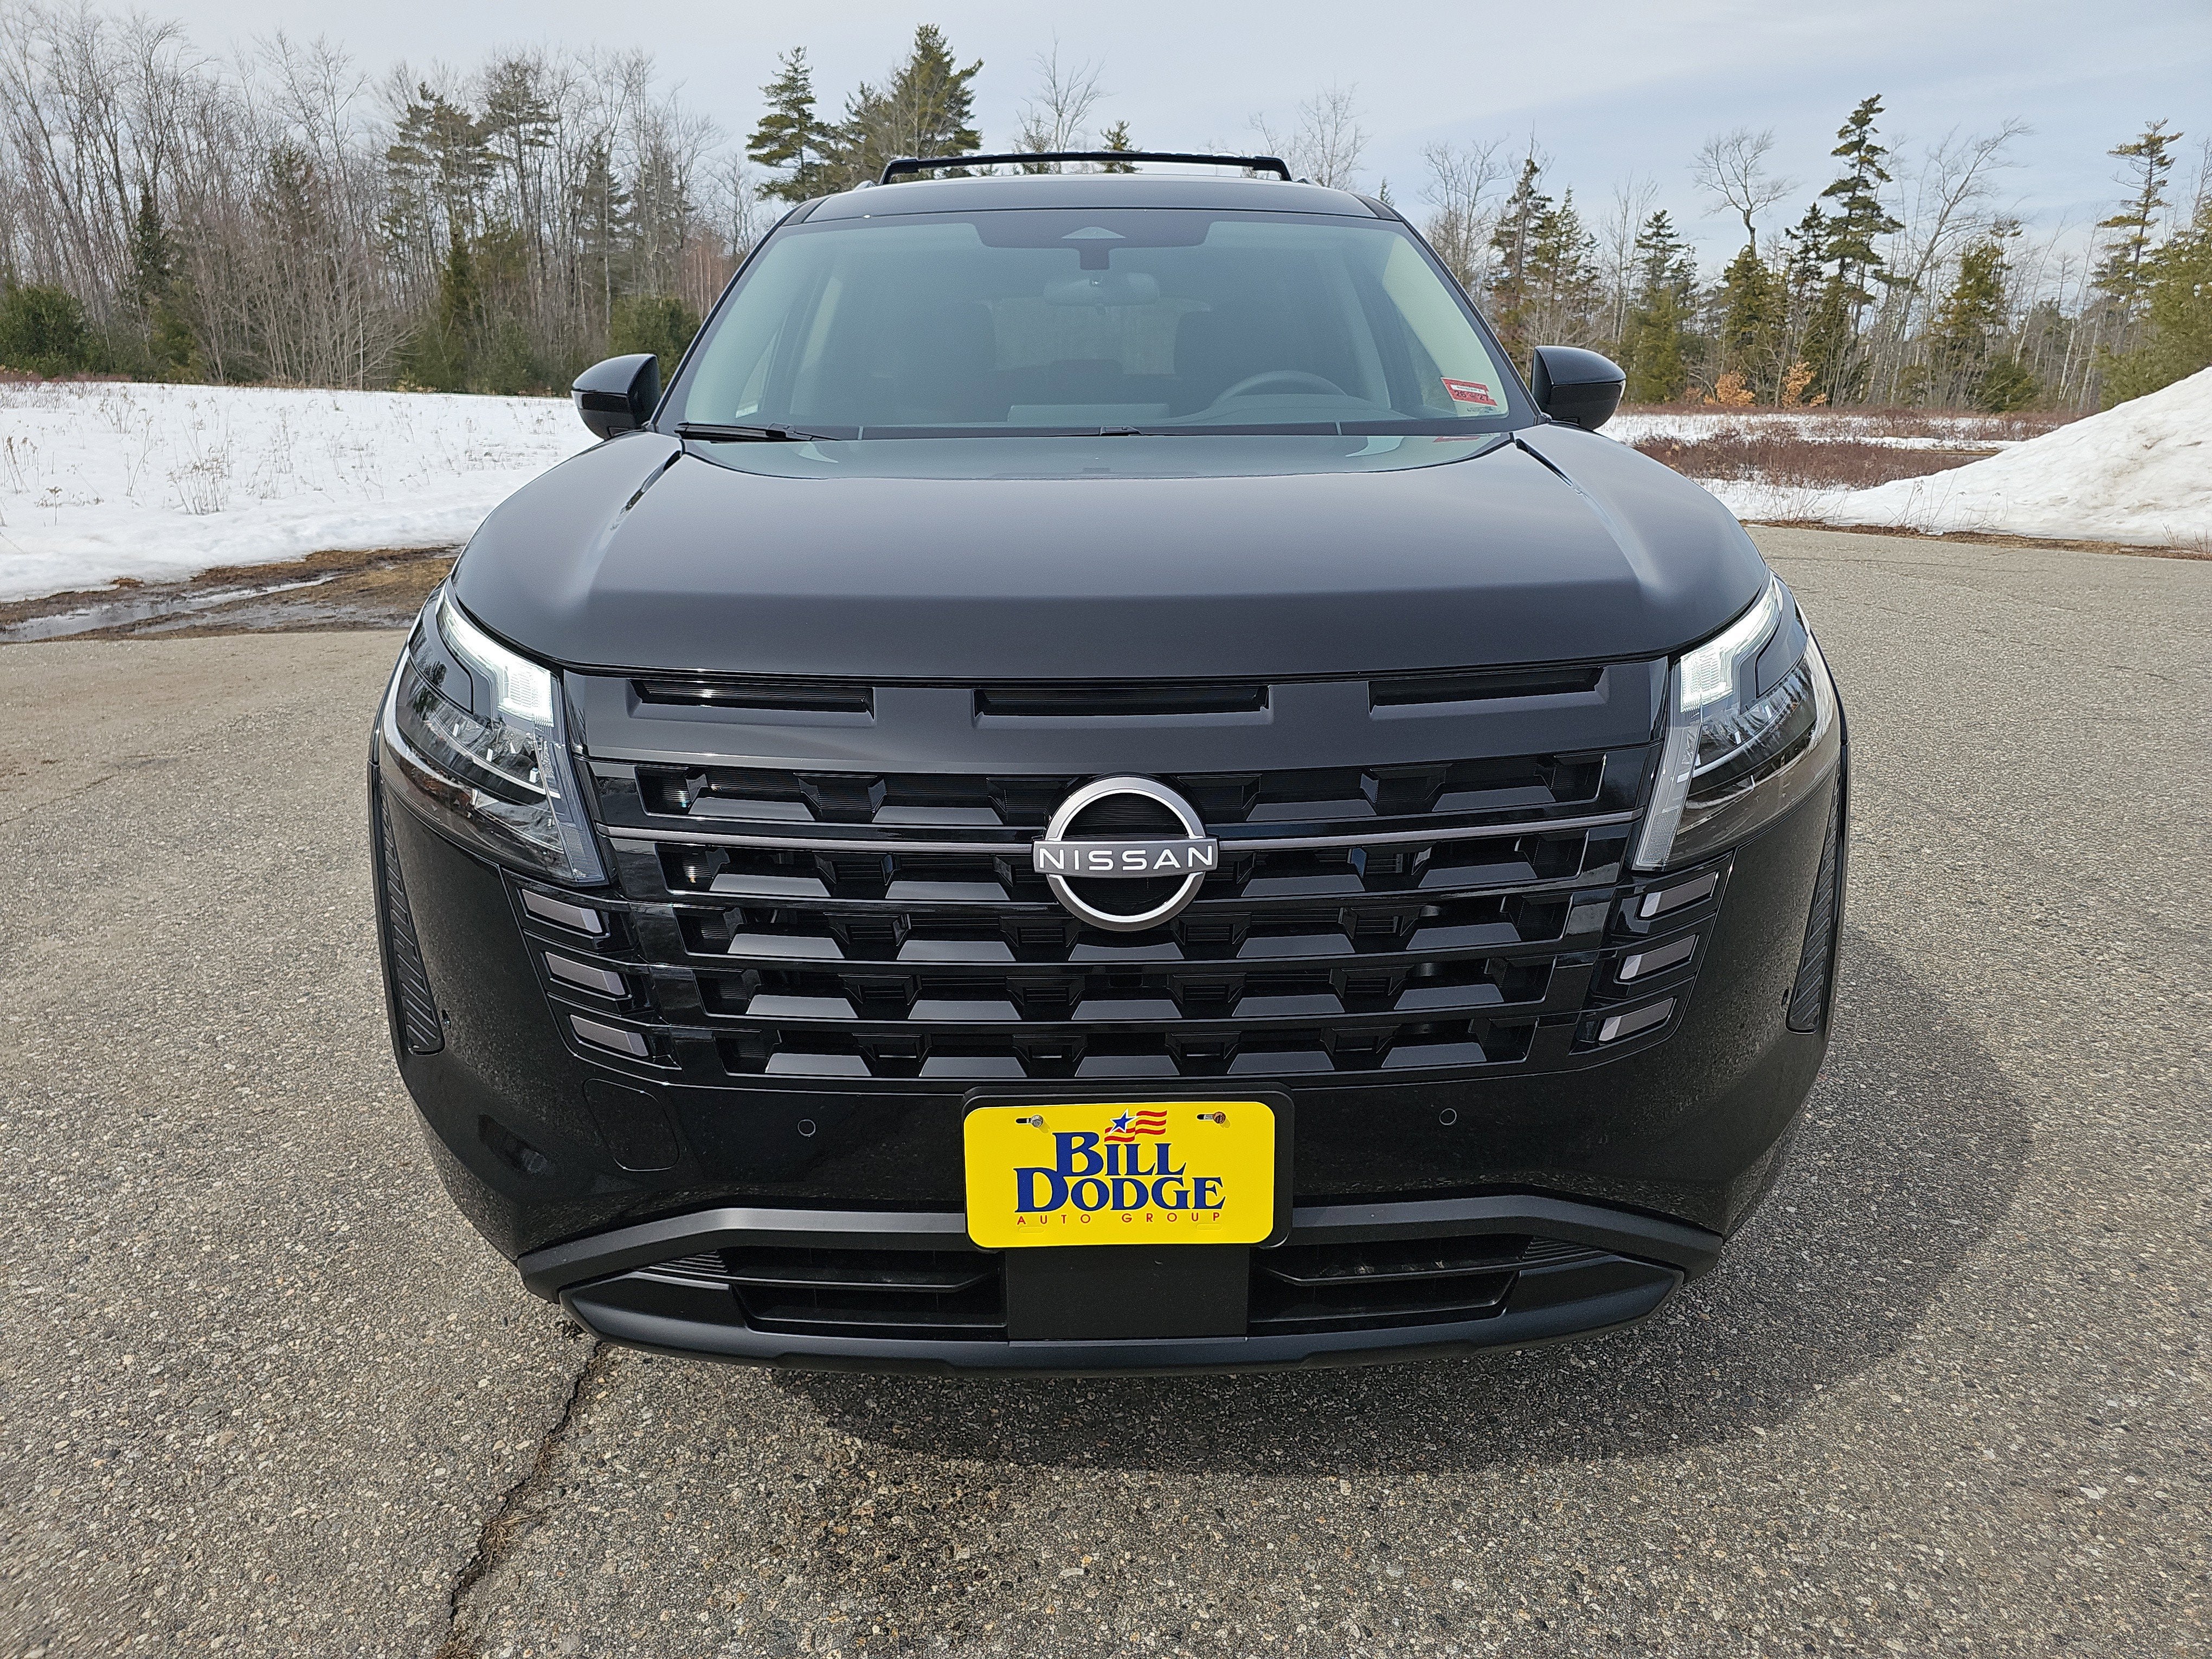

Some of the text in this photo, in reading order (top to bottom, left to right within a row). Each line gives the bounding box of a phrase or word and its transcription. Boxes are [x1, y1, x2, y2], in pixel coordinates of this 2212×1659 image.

[1039, 845, 1212, 871] NISSAN
[1052, 1131, 1187, 1177] BILL
[1013, 1167, 1226, 1213] DODGE
[1017, 1212, 1220, 1225] AUTO GROUP
